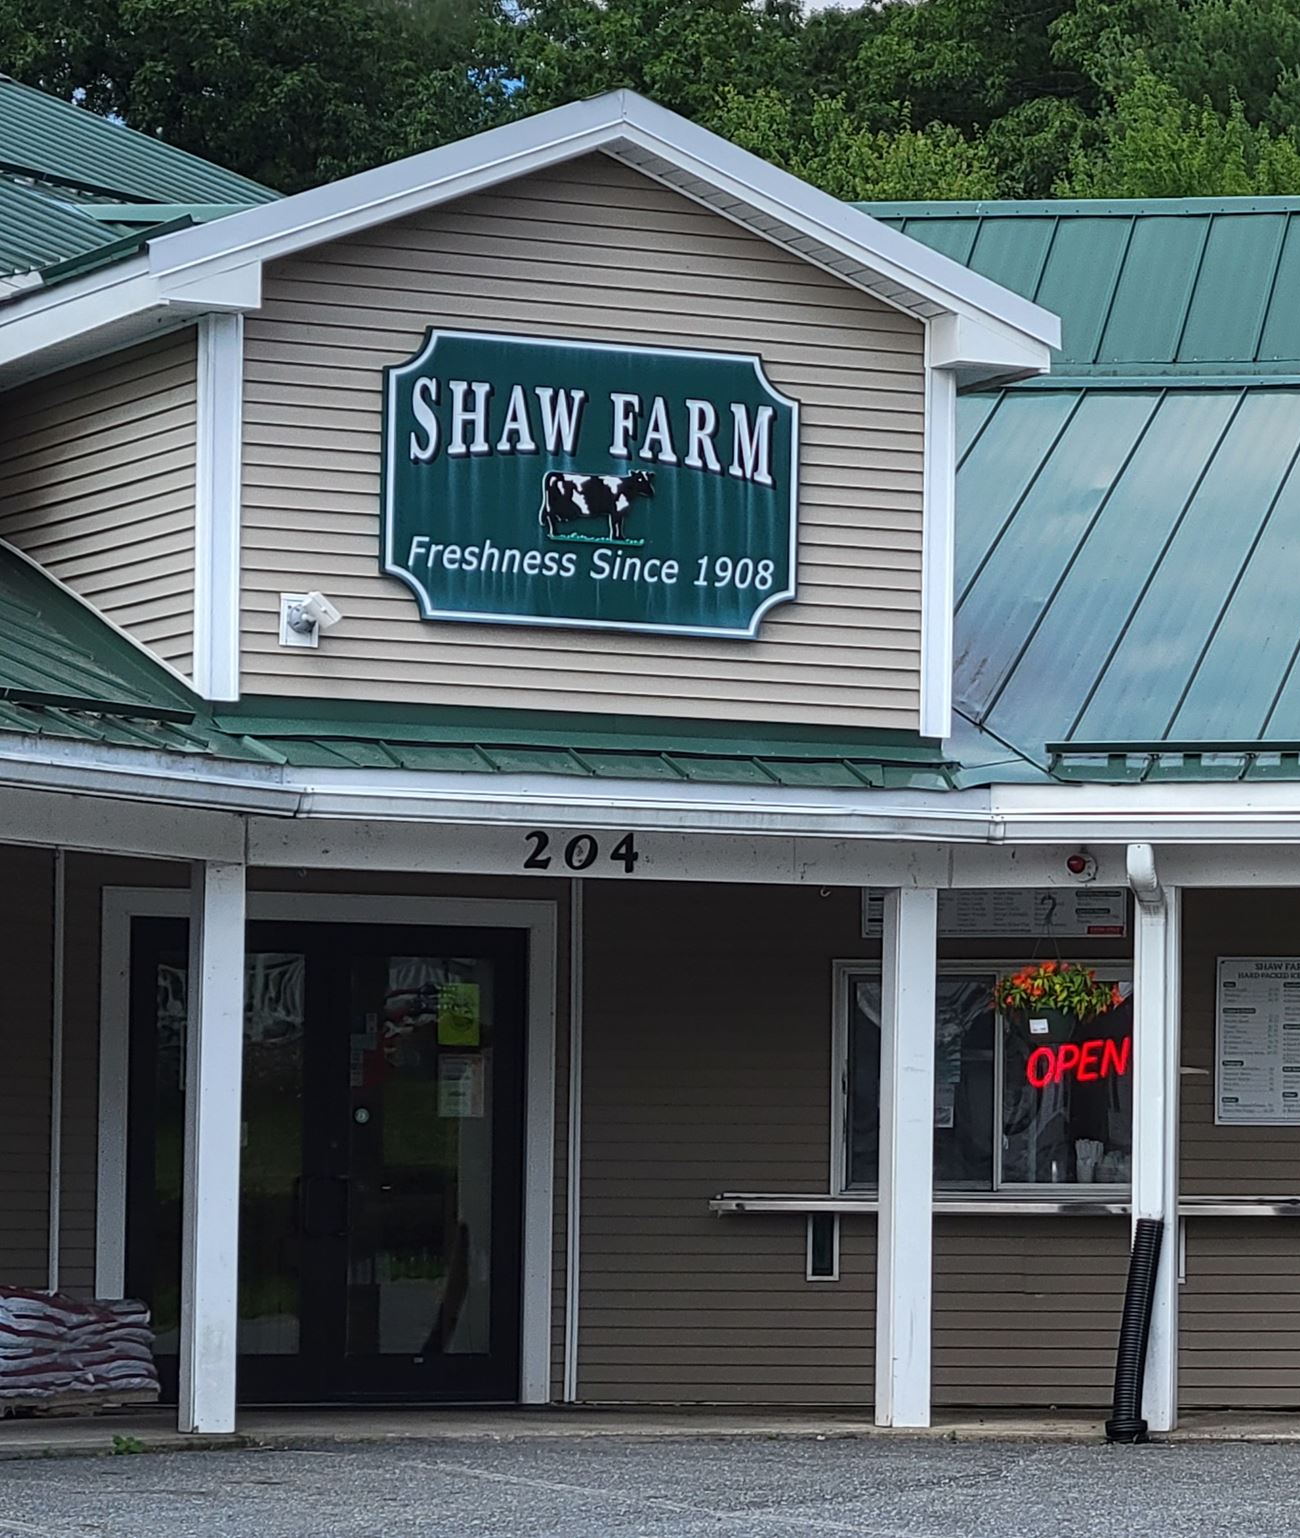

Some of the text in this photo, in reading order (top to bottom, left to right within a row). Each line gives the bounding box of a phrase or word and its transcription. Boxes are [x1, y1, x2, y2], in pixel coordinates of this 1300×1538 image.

[410, 376, 776, 487] SHAW FARM
[408, 536, 775, 590] Freshness Since 1908
[523, 829, 639, 874] 204
[1255, 962, 1284, 971] SHAW
[1026, 1036, 1131, 1089] OPEN
